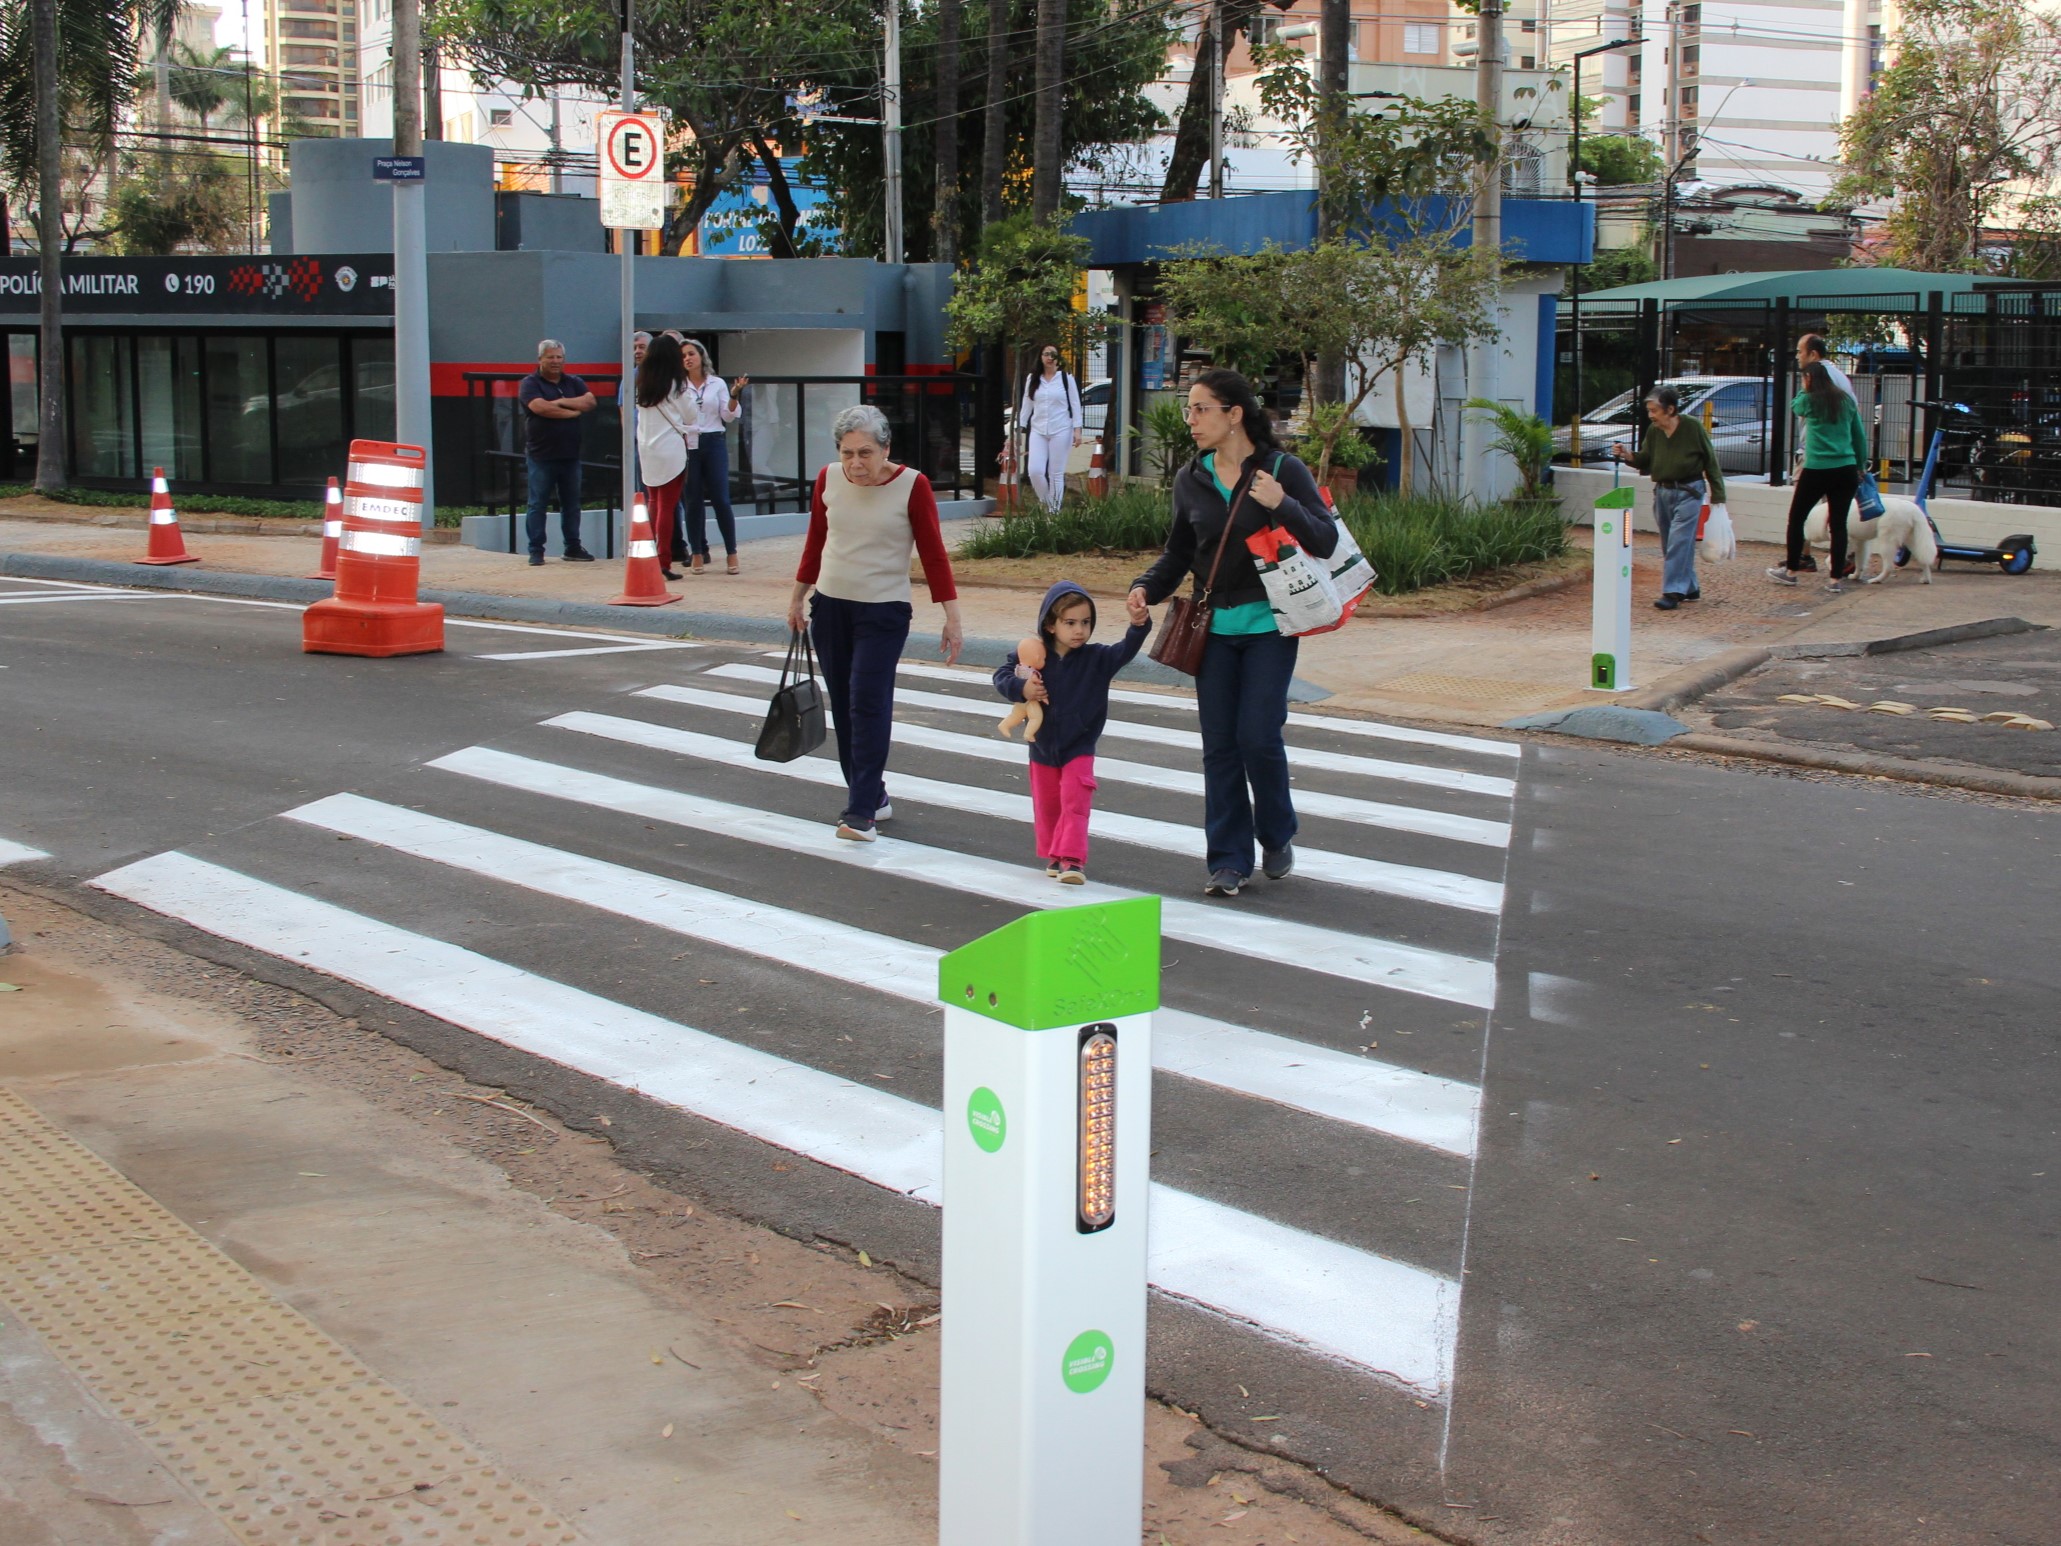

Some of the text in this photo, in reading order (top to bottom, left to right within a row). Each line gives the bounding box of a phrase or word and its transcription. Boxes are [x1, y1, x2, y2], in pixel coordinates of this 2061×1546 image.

[625, 132, 642, 166] E
[377, 159, 413, 169] Praça Nelson
[392, 168, 421, 178] Gonçalves
[69, 274, 140, 294] MILITAR
[184, 274, 215, 295] 190
[362, 502, 408, 516] EMDEC
[1069, 1360, 1105, 1375] CROSSING
